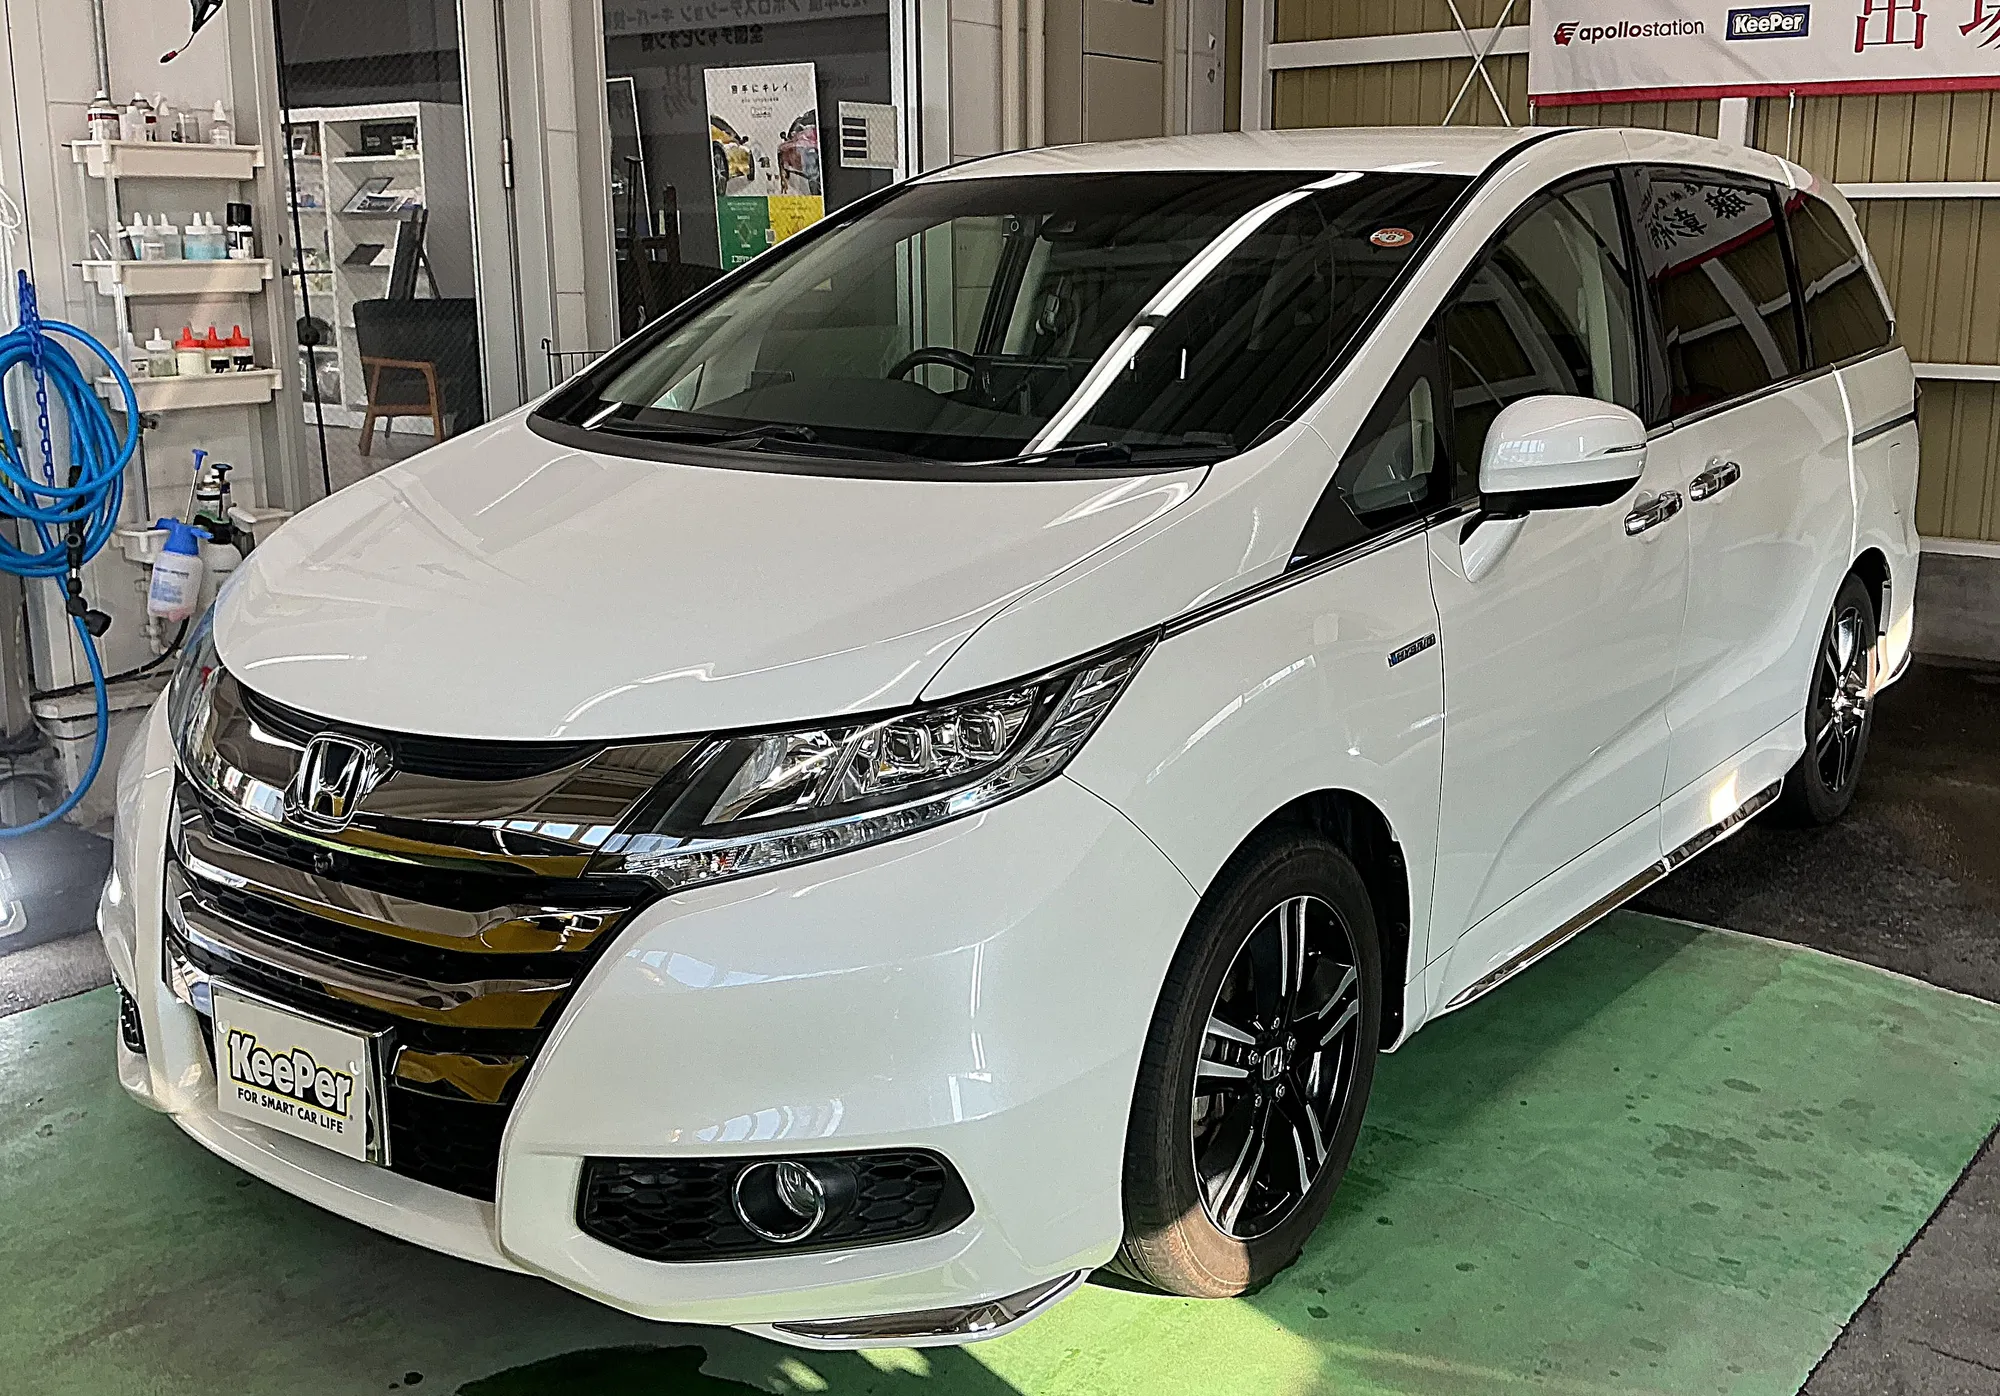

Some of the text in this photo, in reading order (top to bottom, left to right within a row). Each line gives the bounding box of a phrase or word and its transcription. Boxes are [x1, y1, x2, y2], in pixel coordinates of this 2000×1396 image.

[1578, 19, 1704, 45] apollostation
[1732, 13, 1803, 36] KeePer
[228, 1030, 353, 1116] KeePer
[237, 1087, 343, 1134] FOR SMART CAR LIFE
